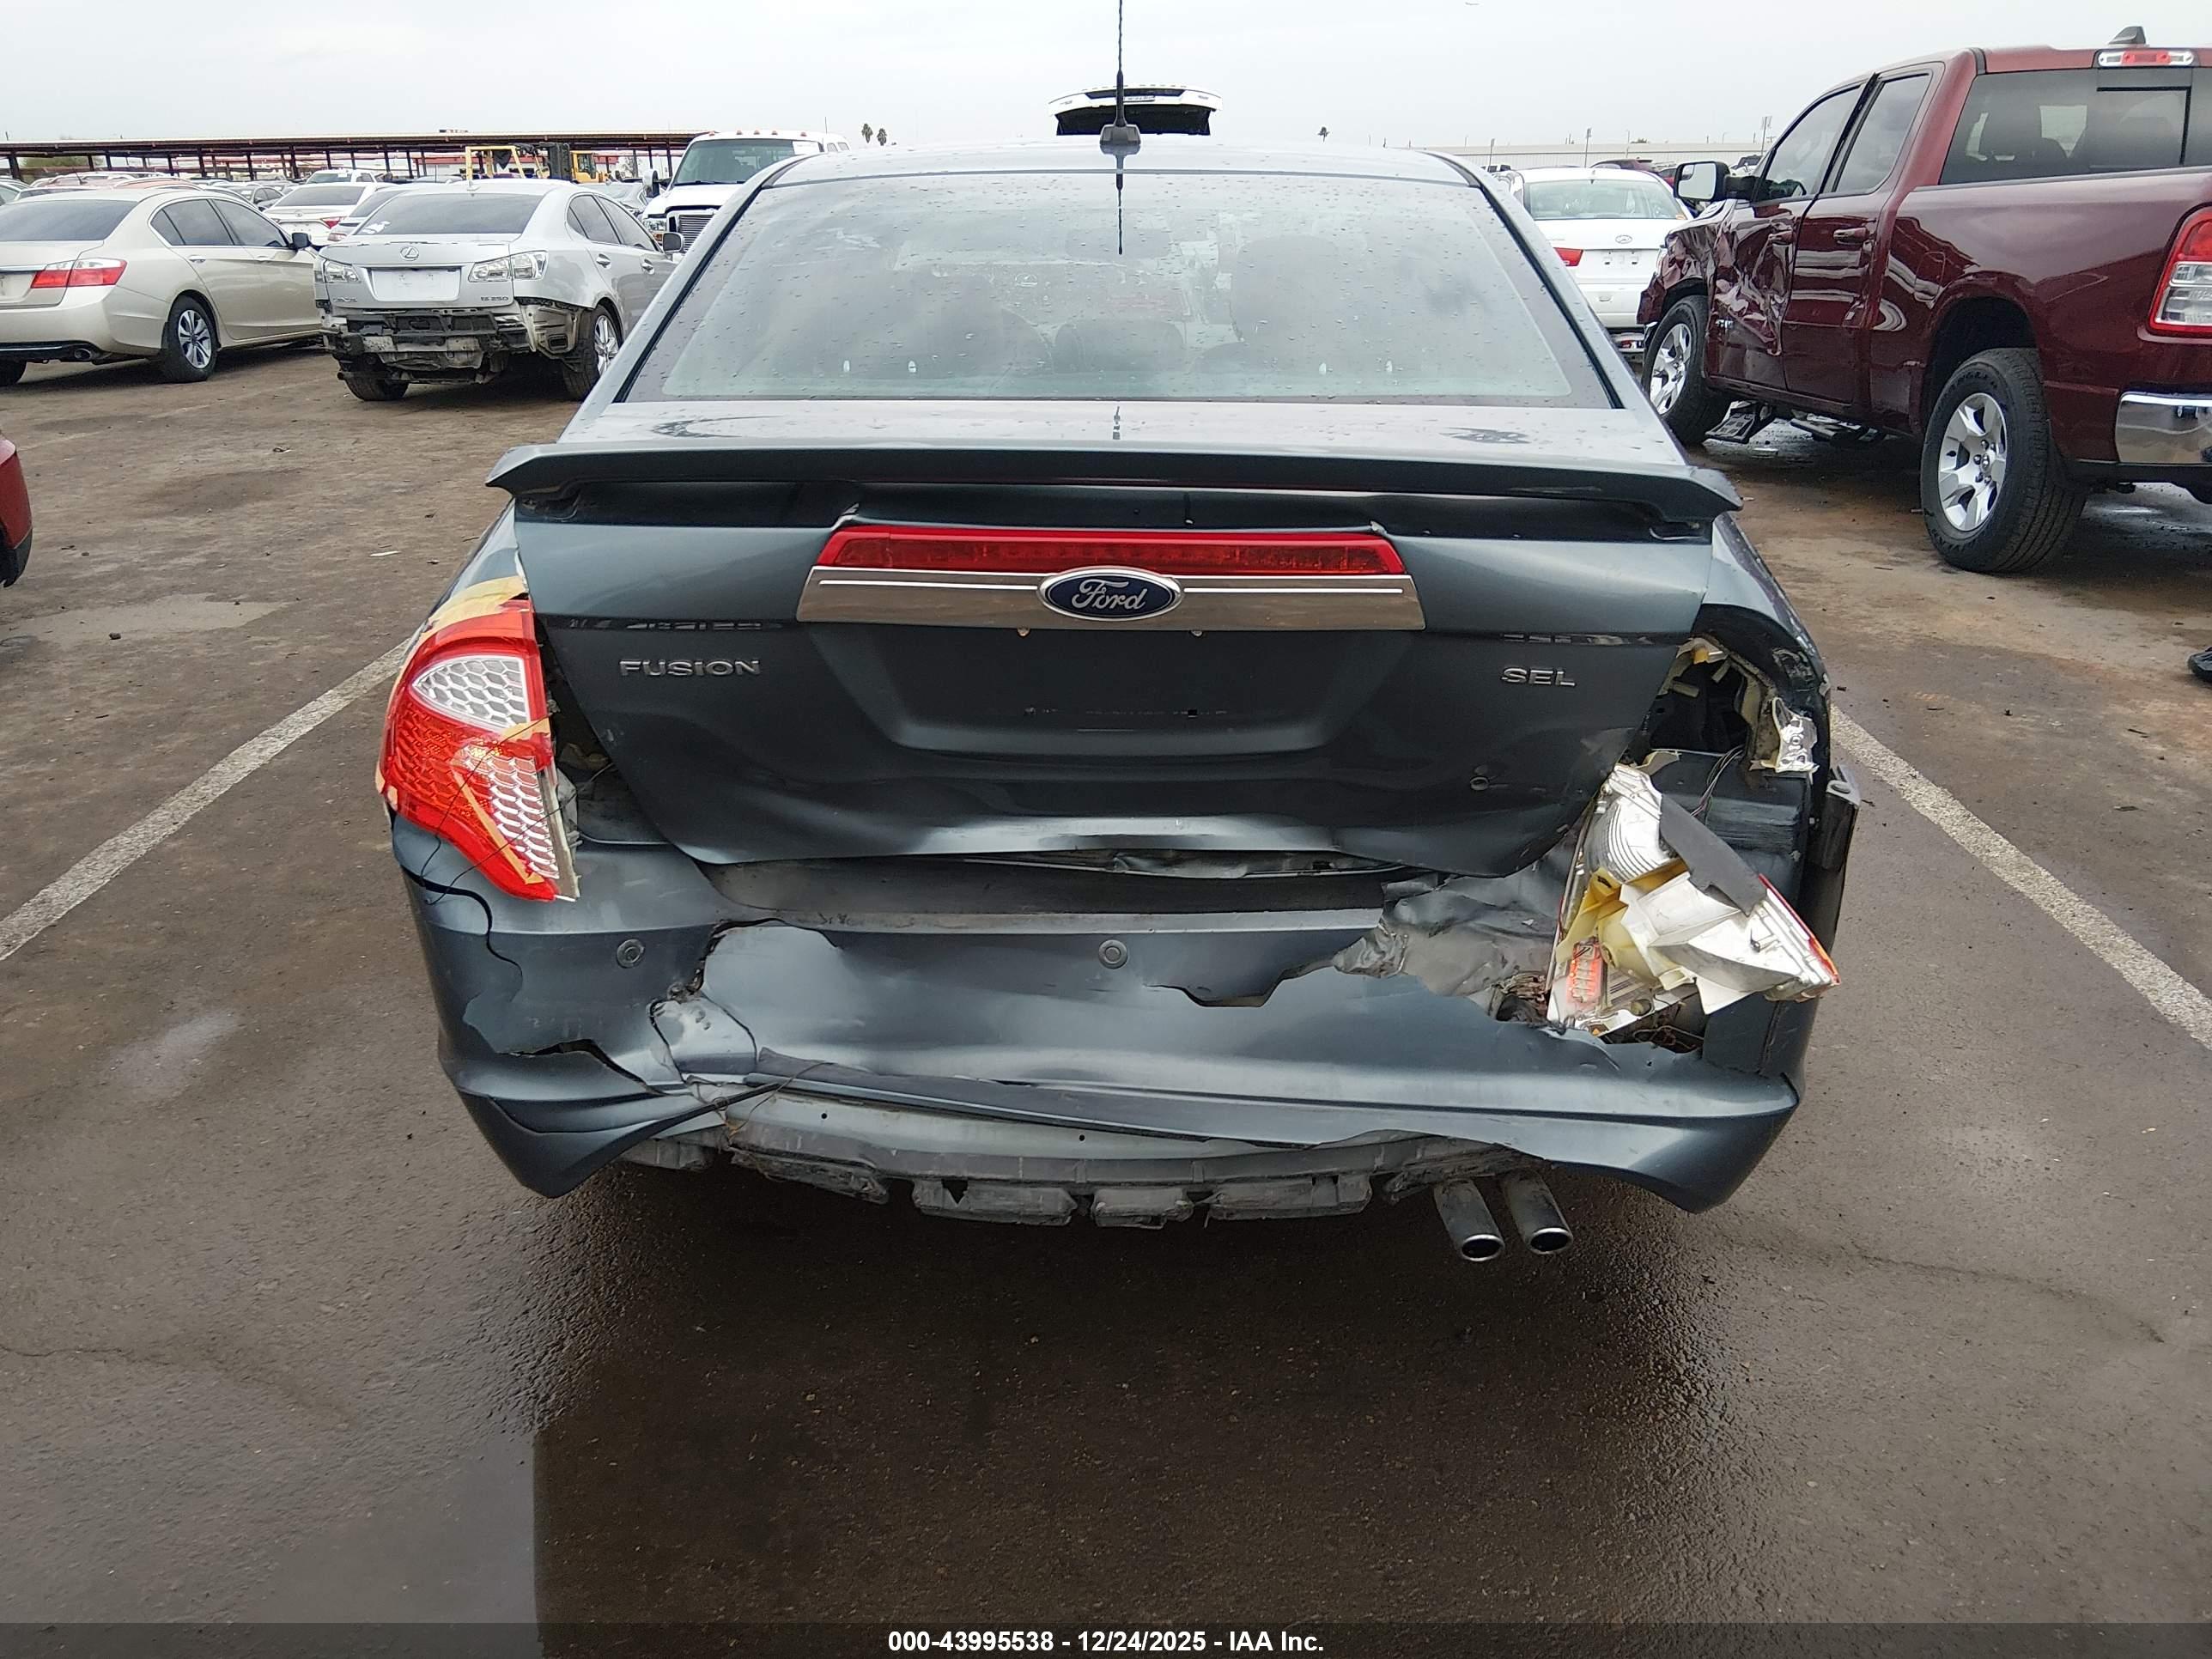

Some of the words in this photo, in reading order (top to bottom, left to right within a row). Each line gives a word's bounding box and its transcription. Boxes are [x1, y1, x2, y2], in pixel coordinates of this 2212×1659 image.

[1072, 579, 1148, 610] Ford
[619, 659, 761, 677] FUSION
[1500, 667, 1576, 686] SEL
